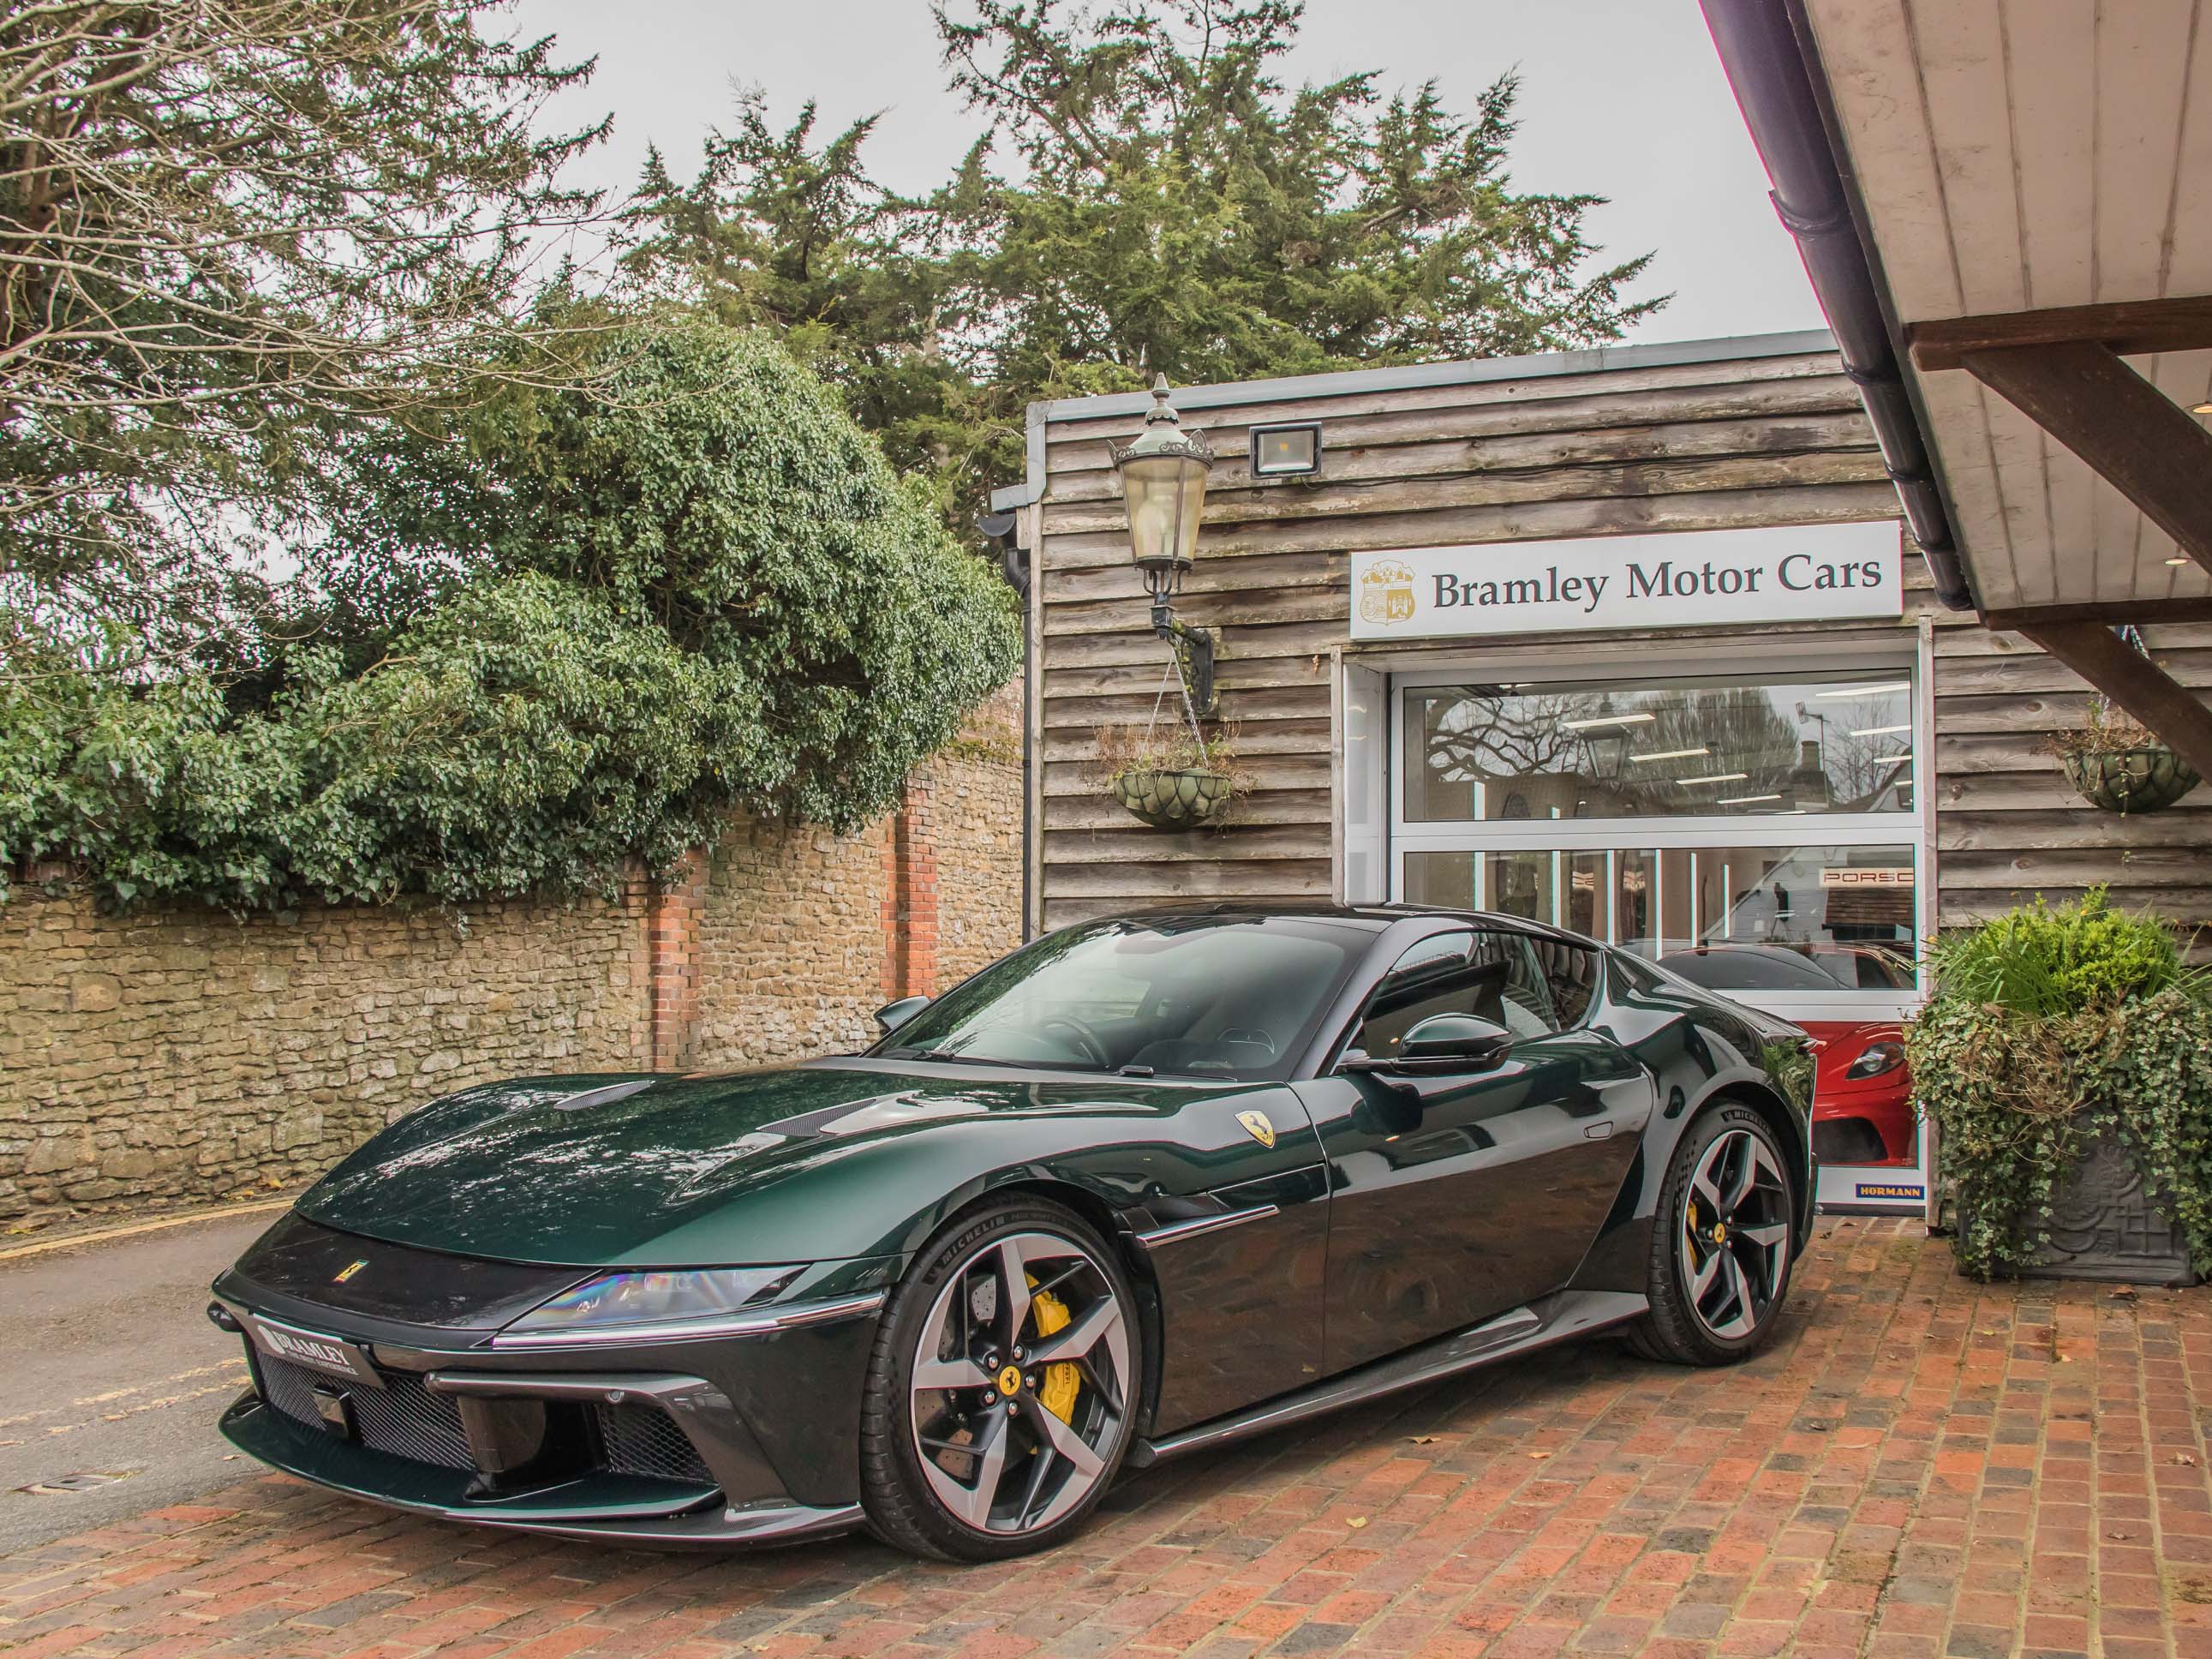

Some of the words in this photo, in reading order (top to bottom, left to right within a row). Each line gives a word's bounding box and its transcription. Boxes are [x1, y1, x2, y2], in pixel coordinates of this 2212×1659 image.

[1432, 566, 1610, 614] Bramley
[1625, 561, 1763, 599] Motor
[1778, 554, 1882, 591] Cars
[942, 1216, 1005, 1264] MICHELIN
[272, 1330, 351, 1366] BRAMLEY
